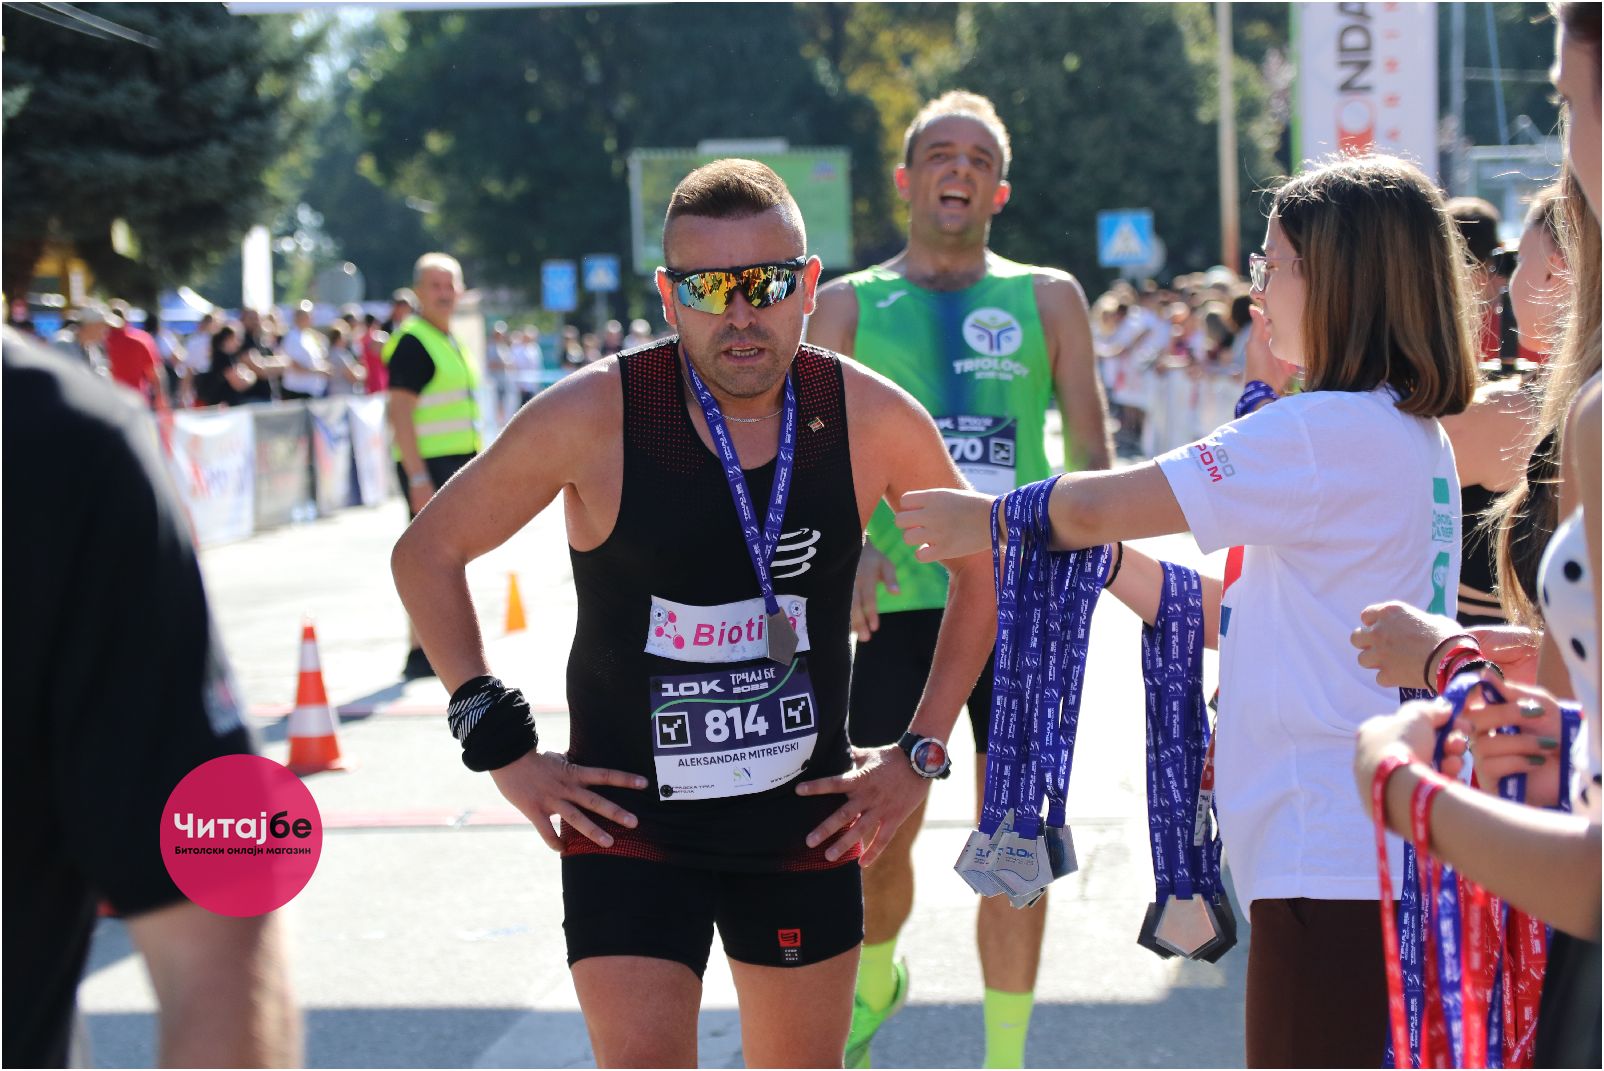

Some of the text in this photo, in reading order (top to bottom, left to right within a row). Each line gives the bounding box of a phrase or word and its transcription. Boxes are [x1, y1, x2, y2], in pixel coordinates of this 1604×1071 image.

[730, 667, 776, 686] ТРЧАЈ БЕ
[662, 679, 725, 697] 10K
[733, 682, 769, 694] 2022
[704, 703, 769, 743] 814
[678, 741, 799, 767] ALEKSANDAR MITREVSKI
